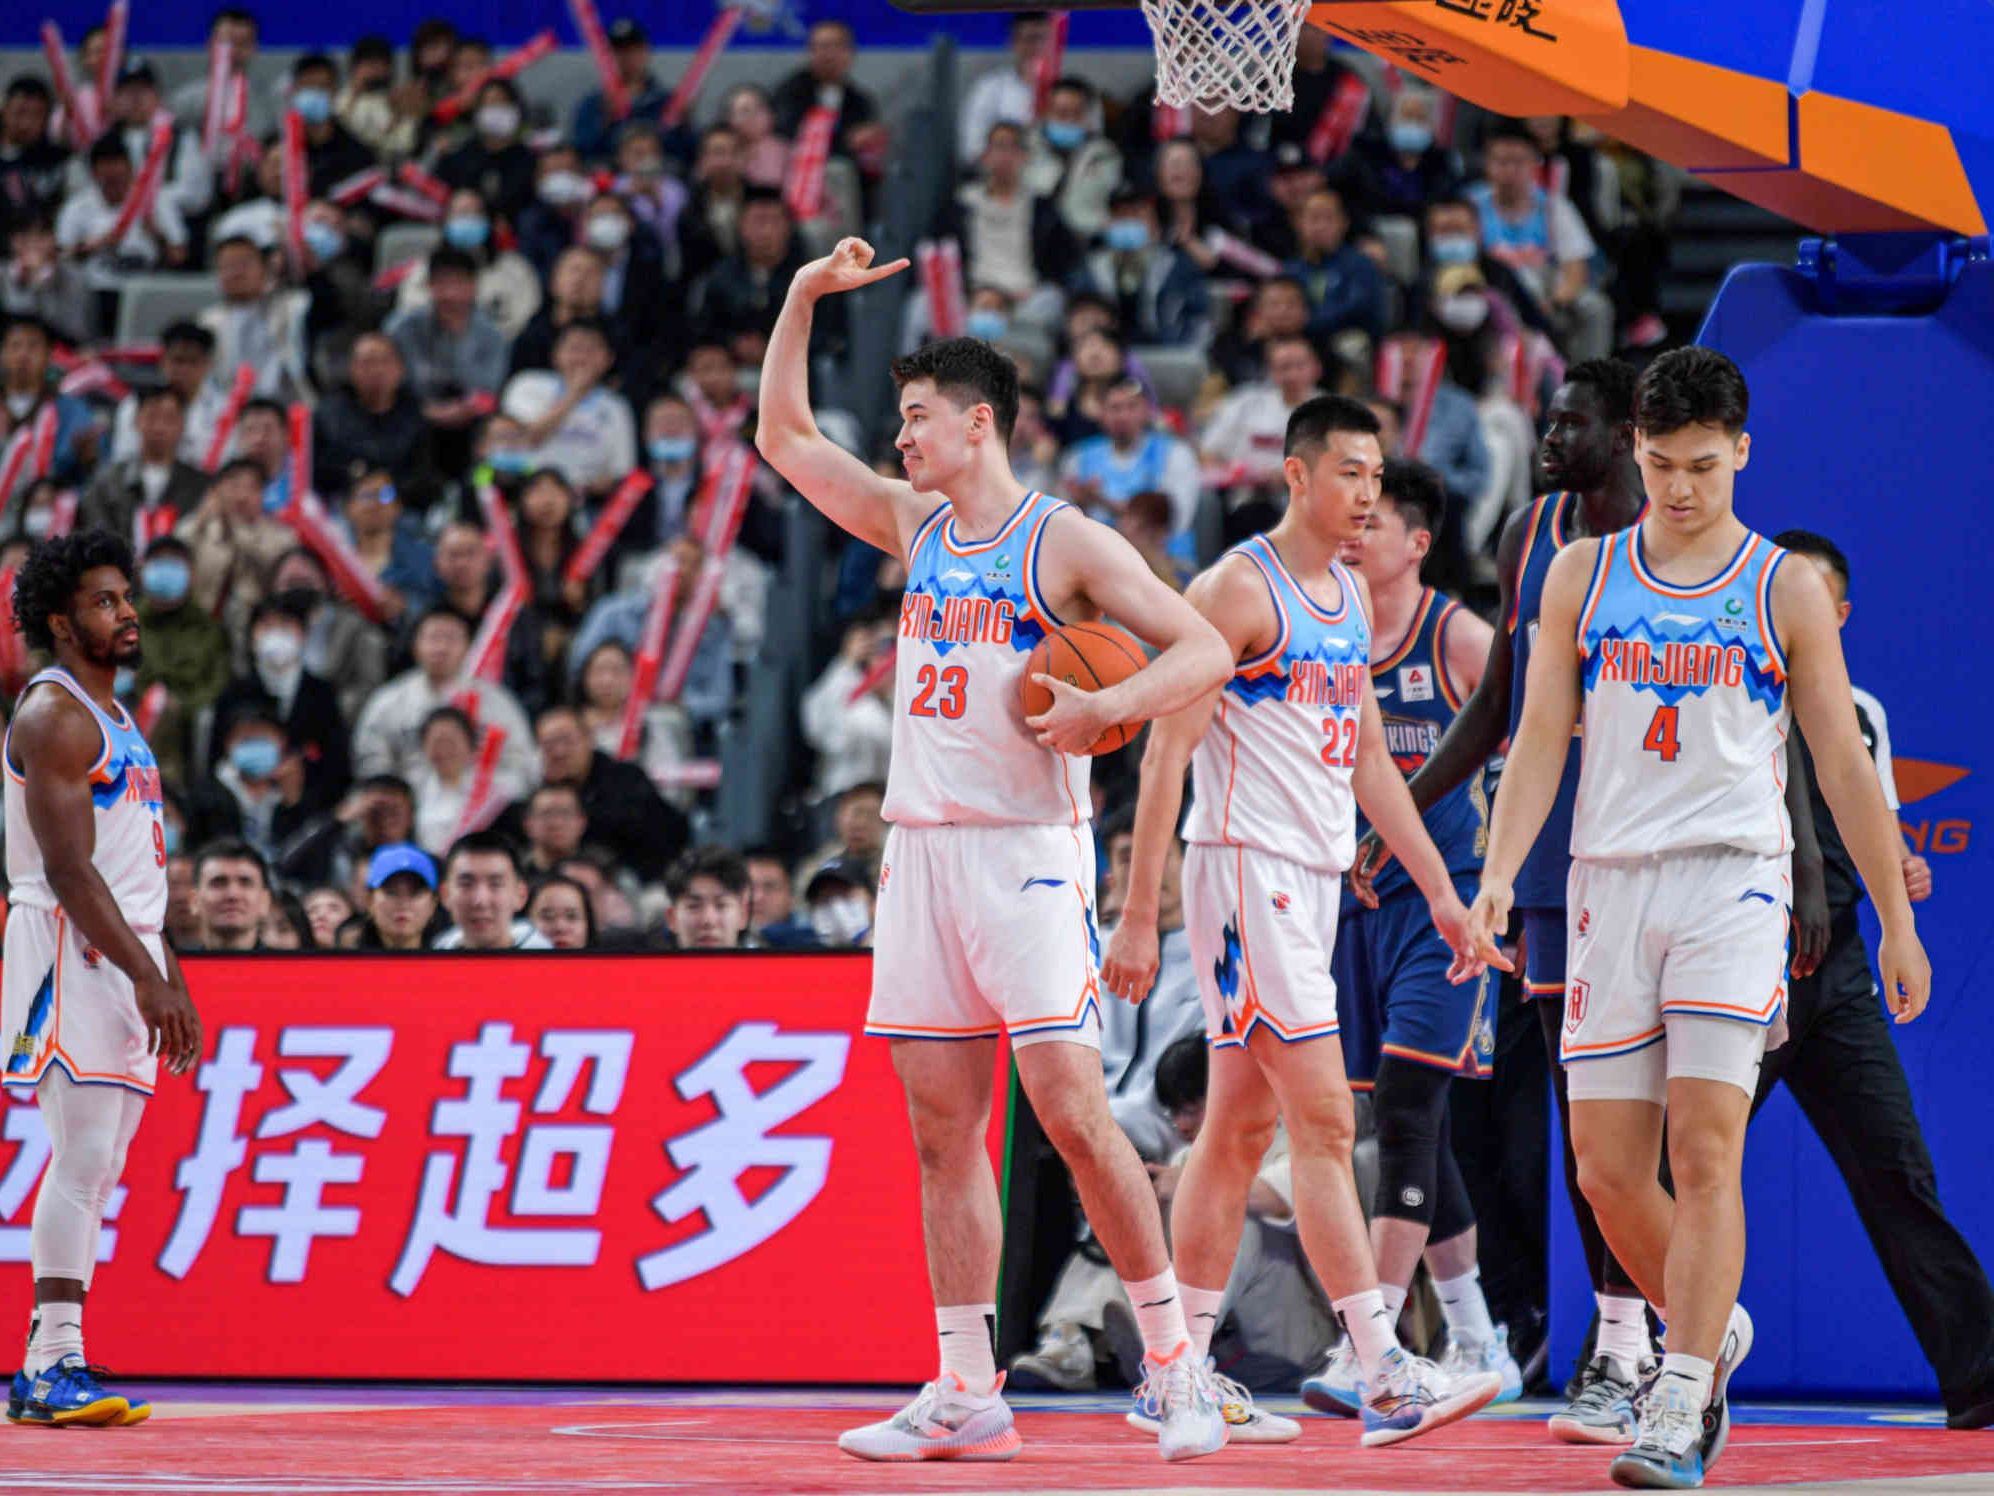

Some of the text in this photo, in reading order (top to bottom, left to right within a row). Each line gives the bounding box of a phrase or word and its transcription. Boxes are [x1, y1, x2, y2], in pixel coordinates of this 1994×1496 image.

[900, 591, 1015, 645] XINJIANG
[1601, 638, 1746, 688] XINJIANG
[909, 663, 969, 720] 23
[1321, 718, 1357, 767] 22
[1643, 705, 1681, 762] 4
[152, 820, 167, 869] 9
